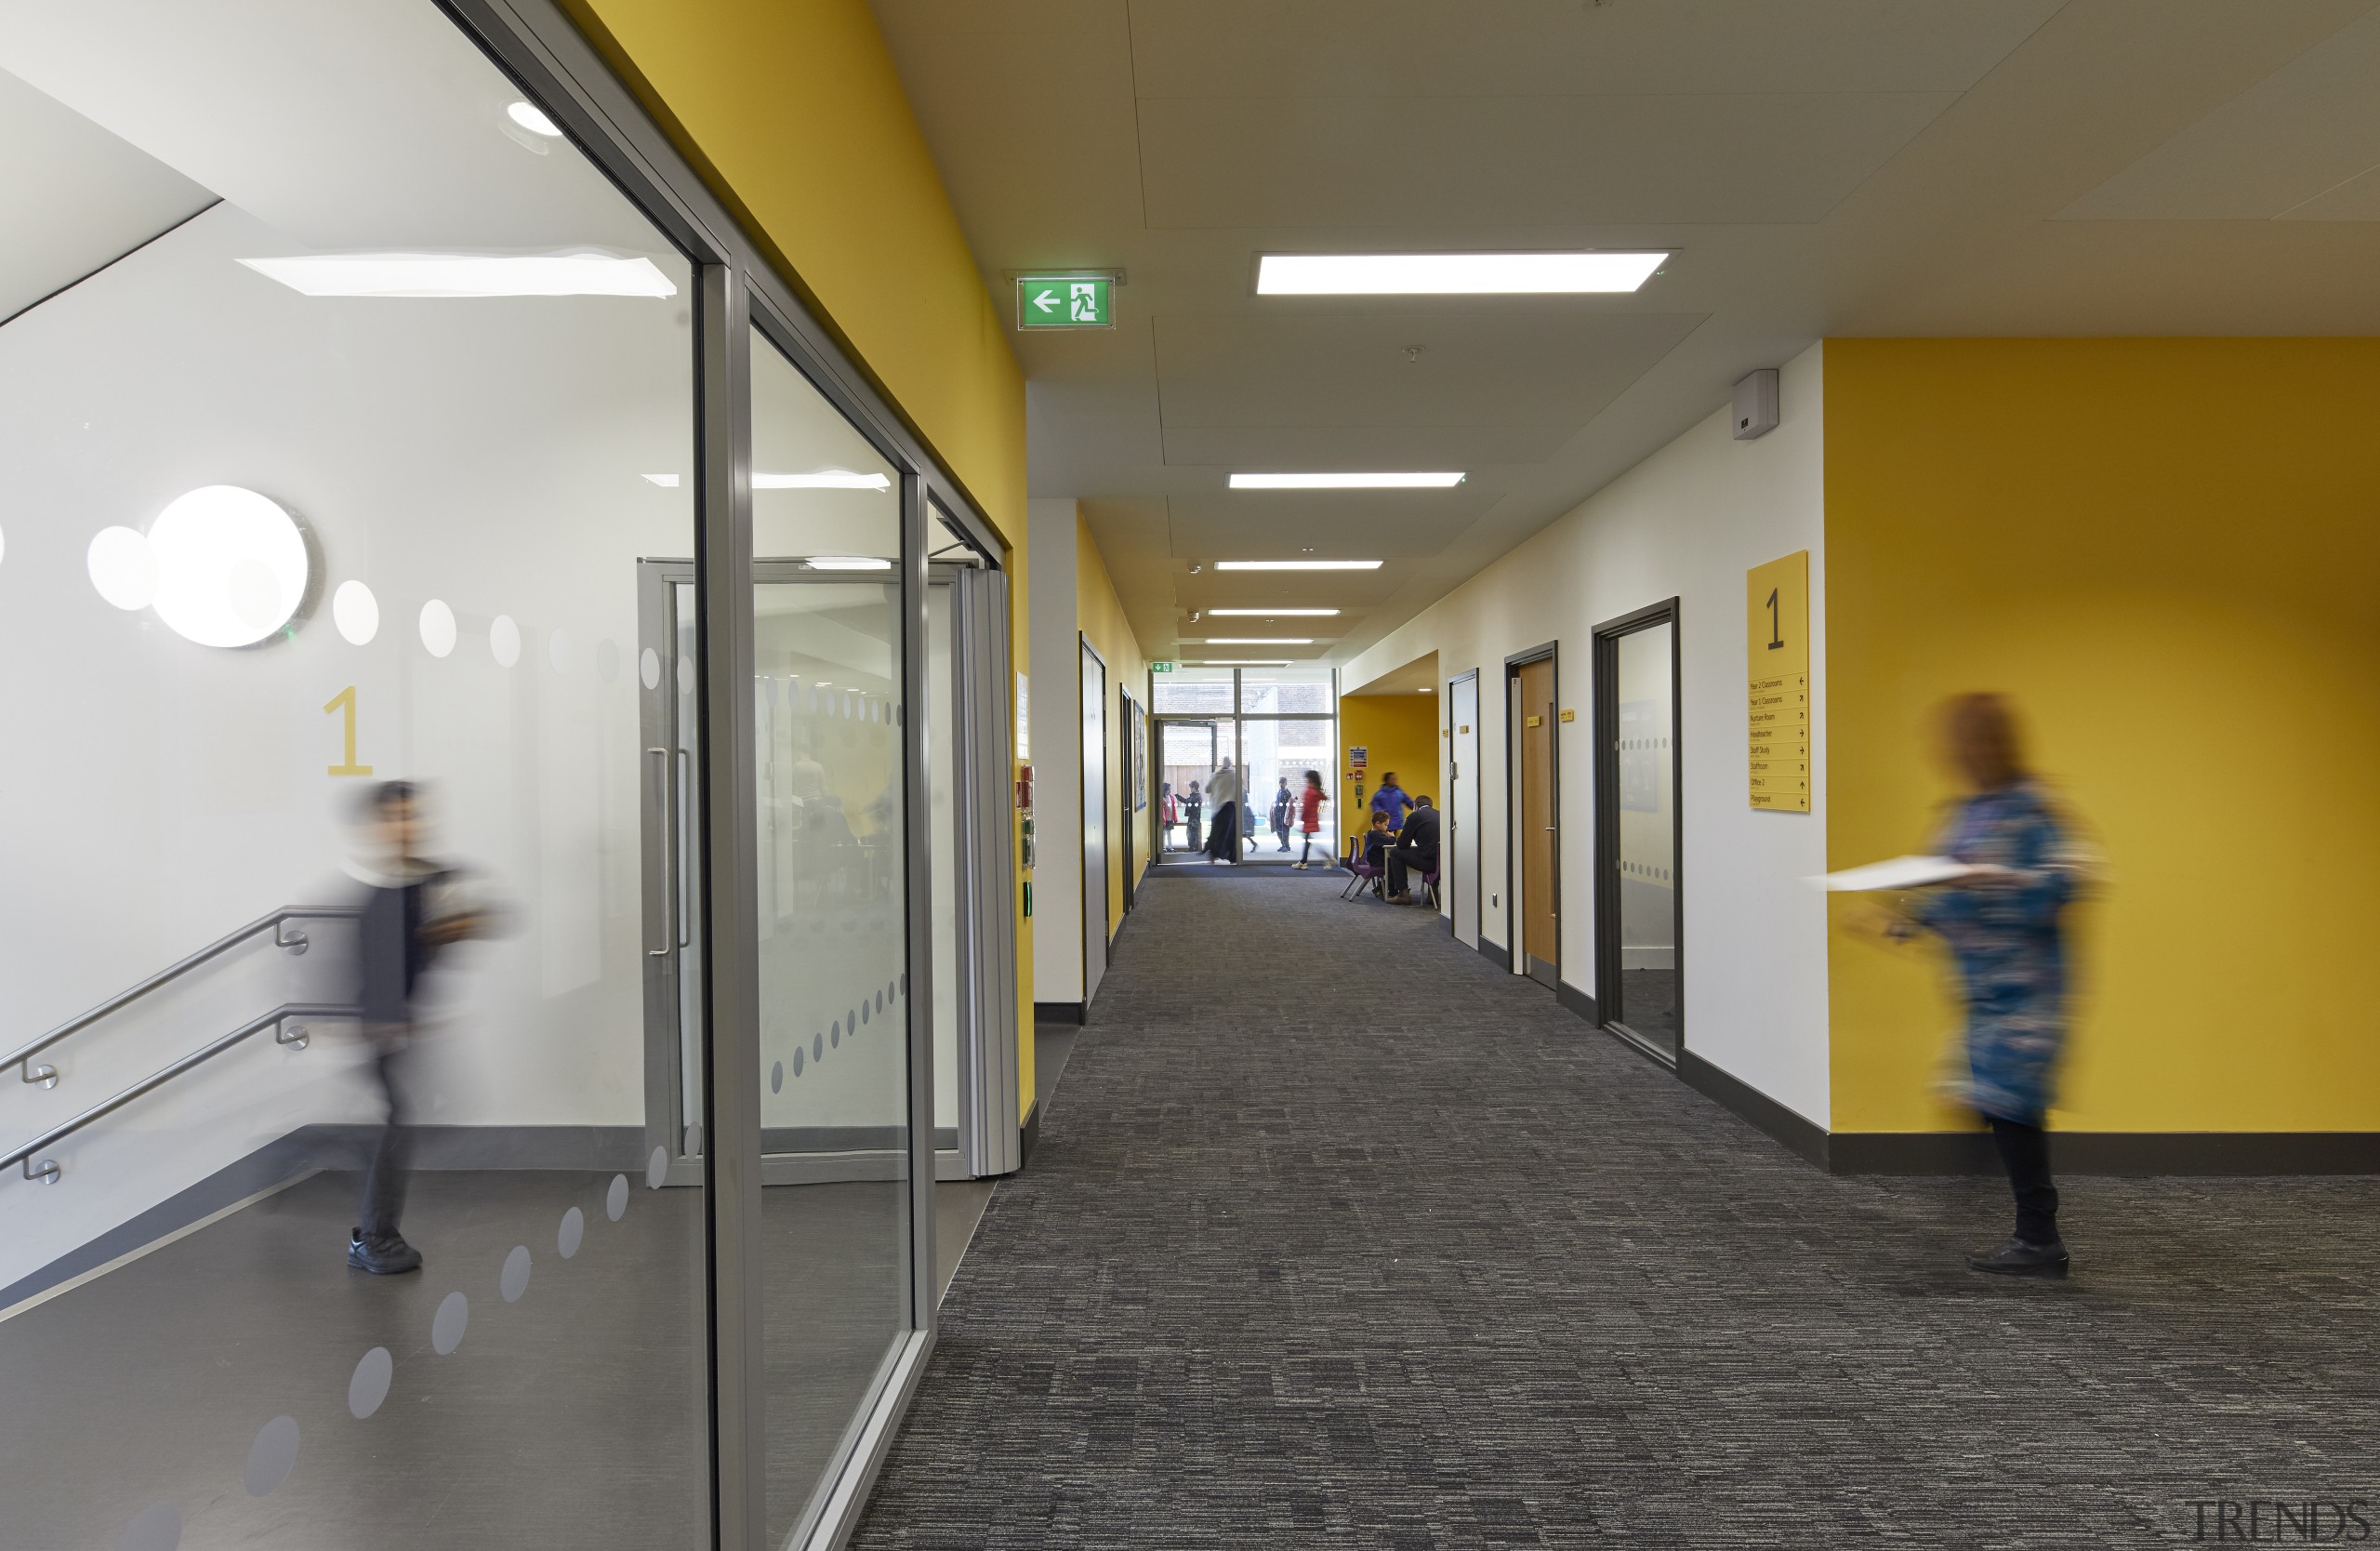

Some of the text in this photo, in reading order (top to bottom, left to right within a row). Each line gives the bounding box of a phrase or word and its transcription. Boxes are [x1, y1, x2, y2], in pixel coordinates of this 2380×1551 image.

[1766, 587, 1784, 651] 1
[1762, 680, 1782, 689] Classrooms
[1762, 696, 1782, 705] Classrooms
[323, 685, 373, 776] 1
[1759, 746, 1770, 754] Study
[1750, 794, 1771, 803] Playground
